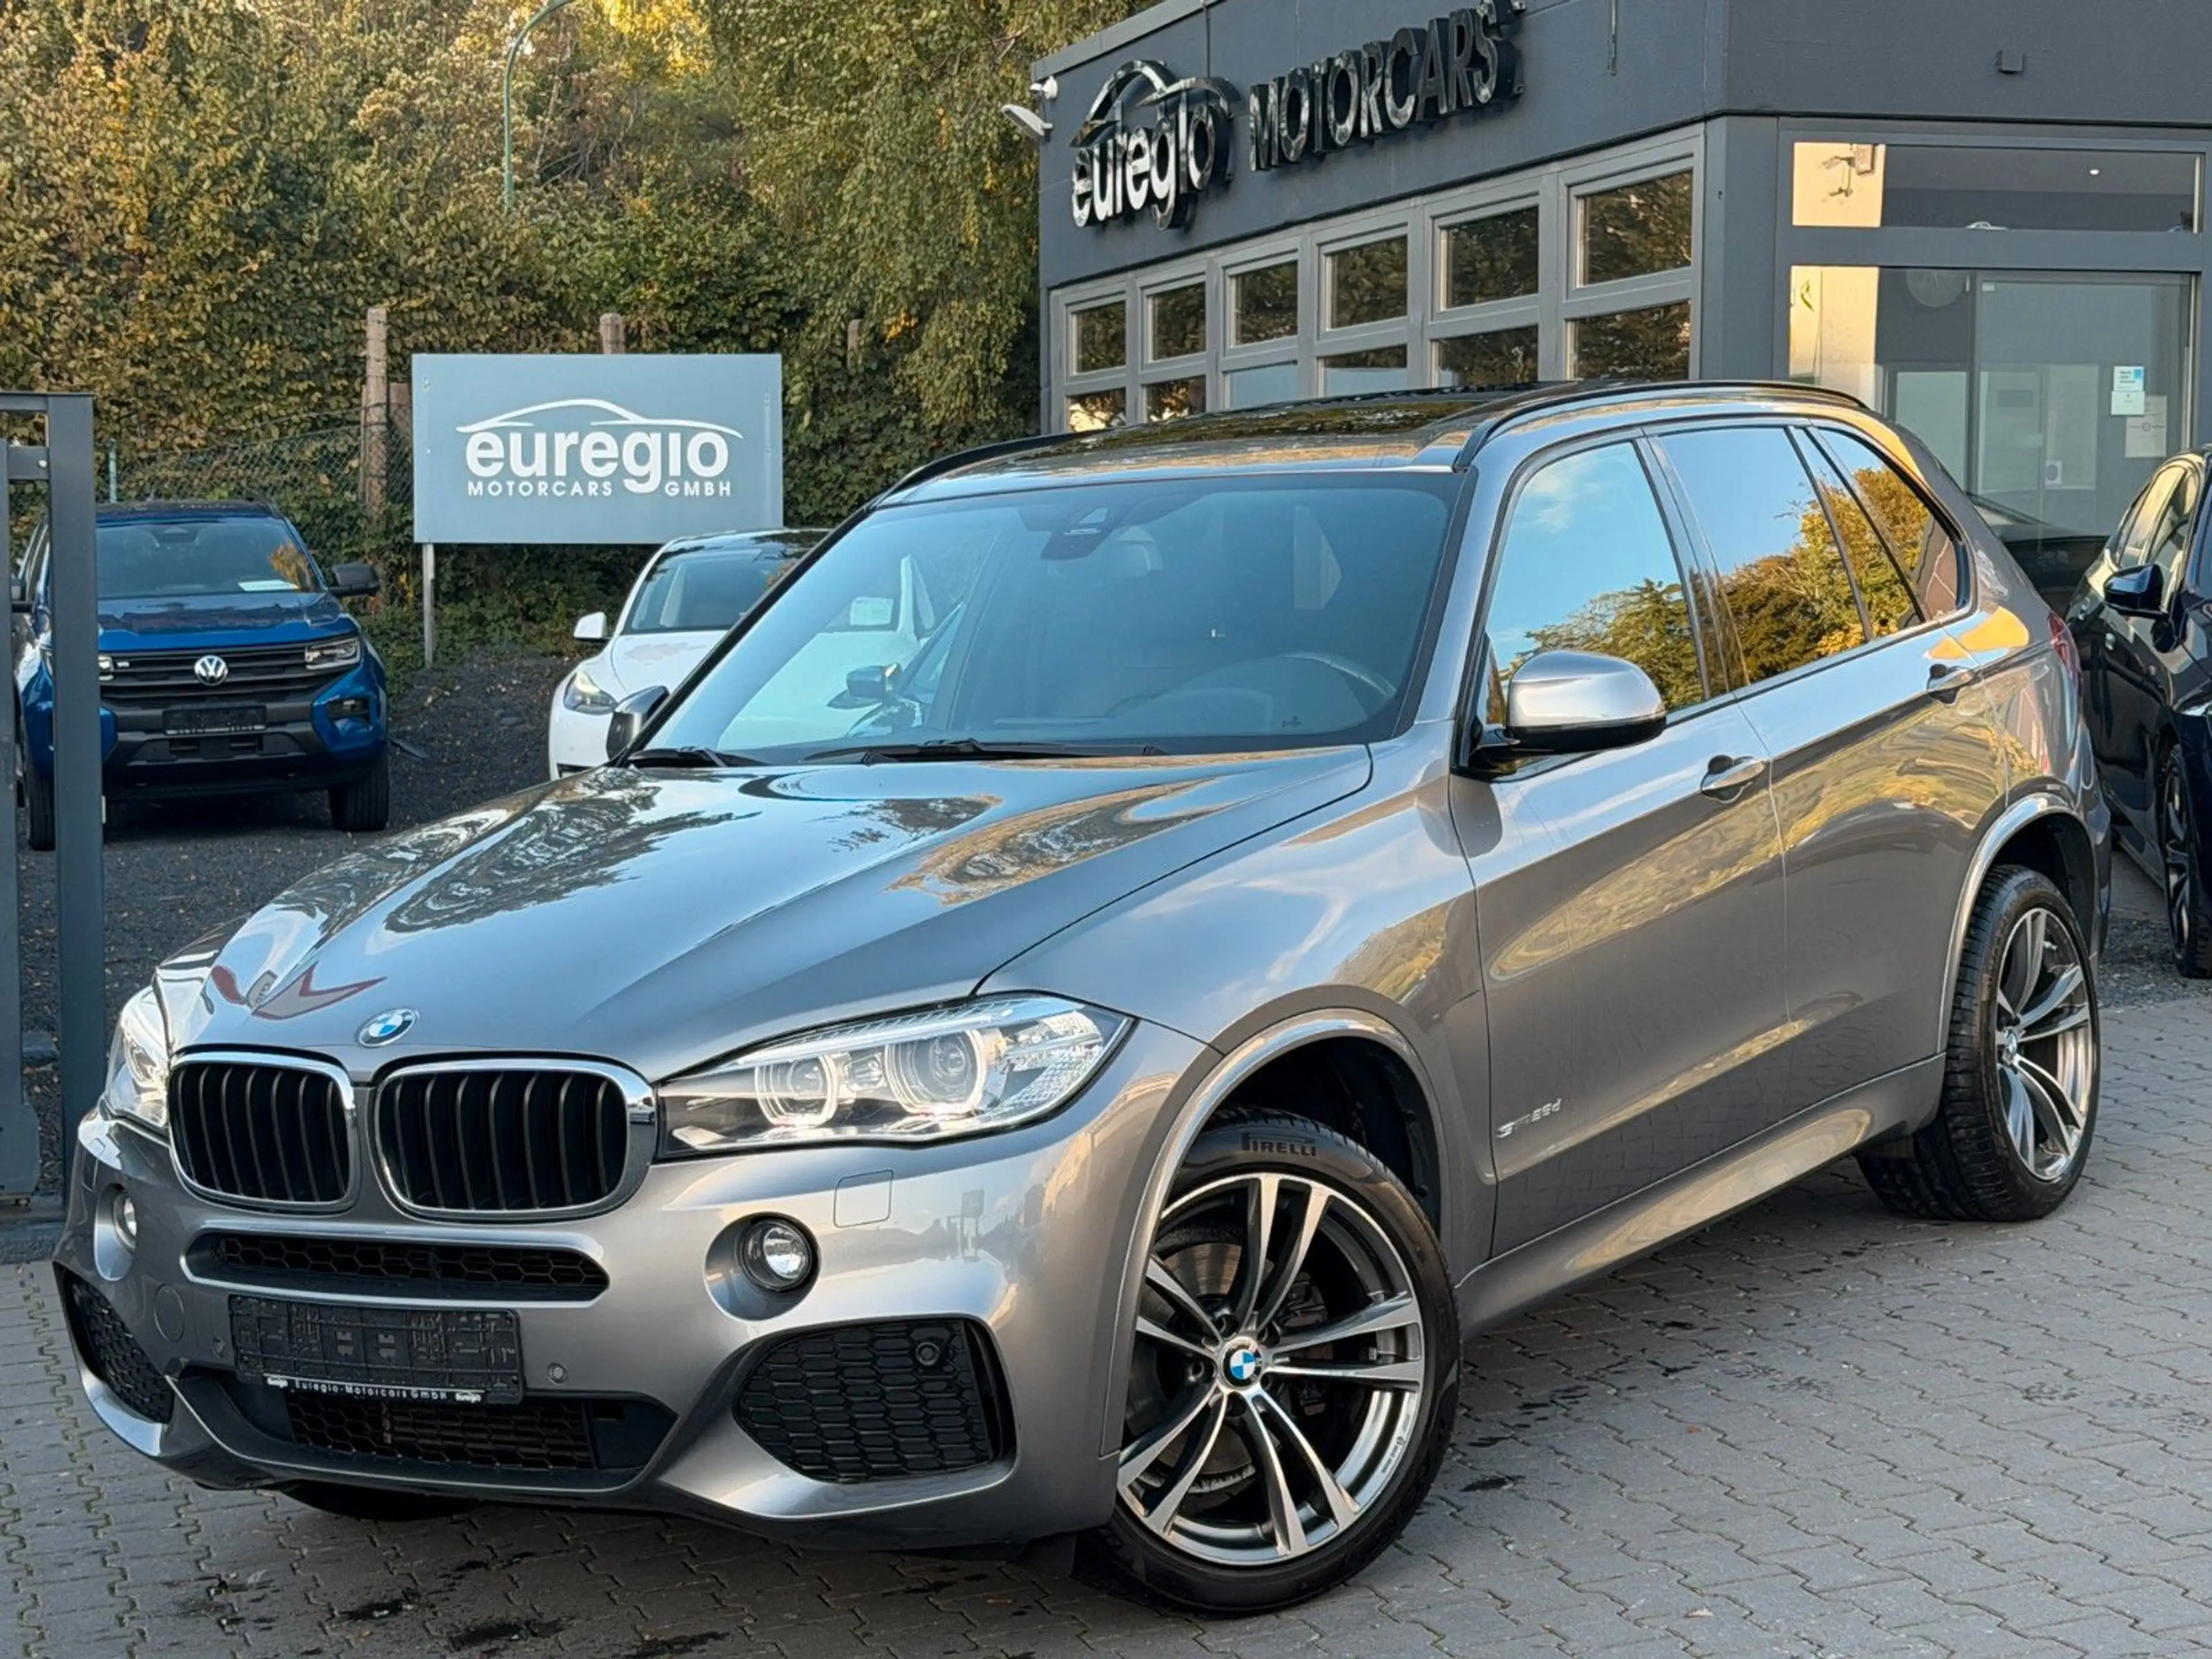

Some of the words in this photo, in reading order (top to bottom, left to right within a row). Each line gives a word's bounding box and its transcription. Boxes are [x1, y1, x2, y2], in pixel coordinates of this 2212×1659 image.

[1071, 103, 1217, 230] euregio
[1249, 0, 1499, 172] MOTORCARS
[466, 431, 728, 493] euregio
[468, 480, 612, 497] MOTORCARS
[665, 480, 730, 497] GMBH
[1241, 1132, 1316, 1156] PIRELLI
